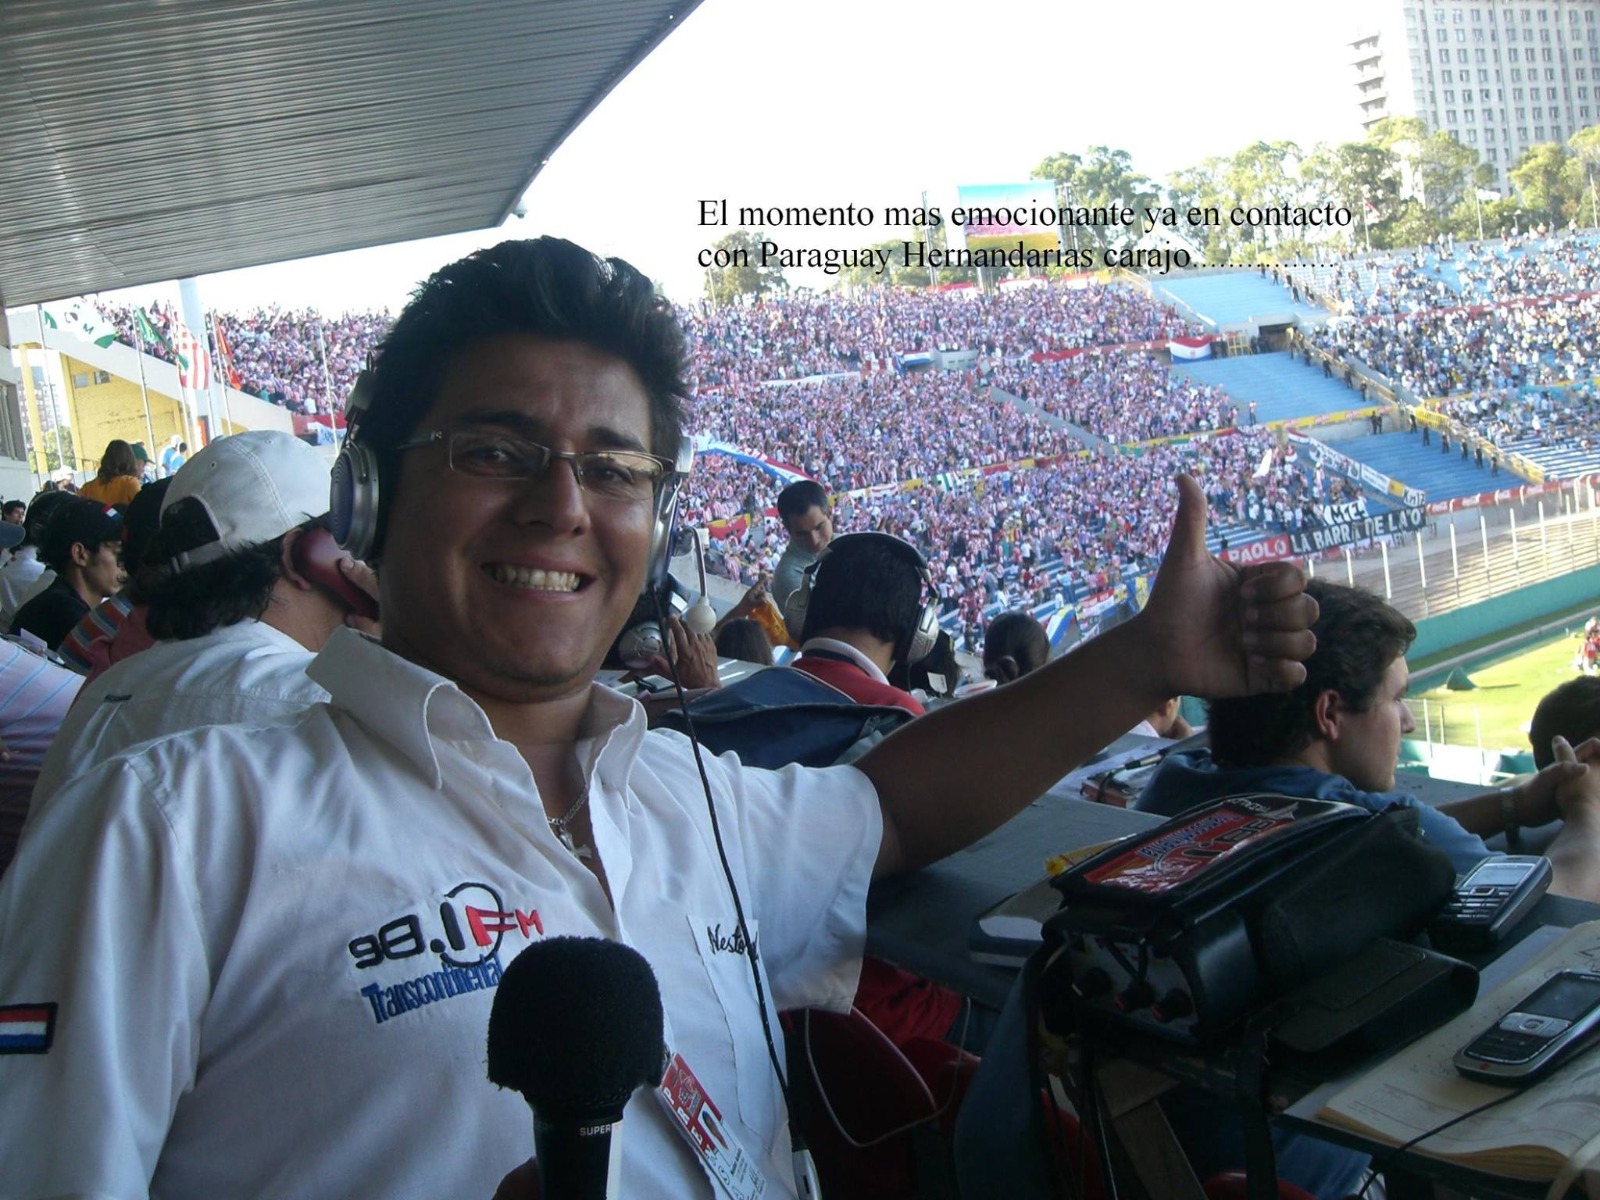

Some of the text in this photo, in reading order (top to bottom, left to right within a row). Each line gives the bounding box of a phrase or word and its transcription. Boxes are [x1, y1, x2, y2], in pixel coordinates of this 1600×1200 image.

[1228, 539, 1287, 565] PAOLO
[1290, 533, 1312, 554] LA
[1313, 522, 1362, 550] BARRA
[1364, 515, 1385, 538] DE
[348, 901, 465, 969] 98.1
[360, 953, 504, 1024] Transcontinental
